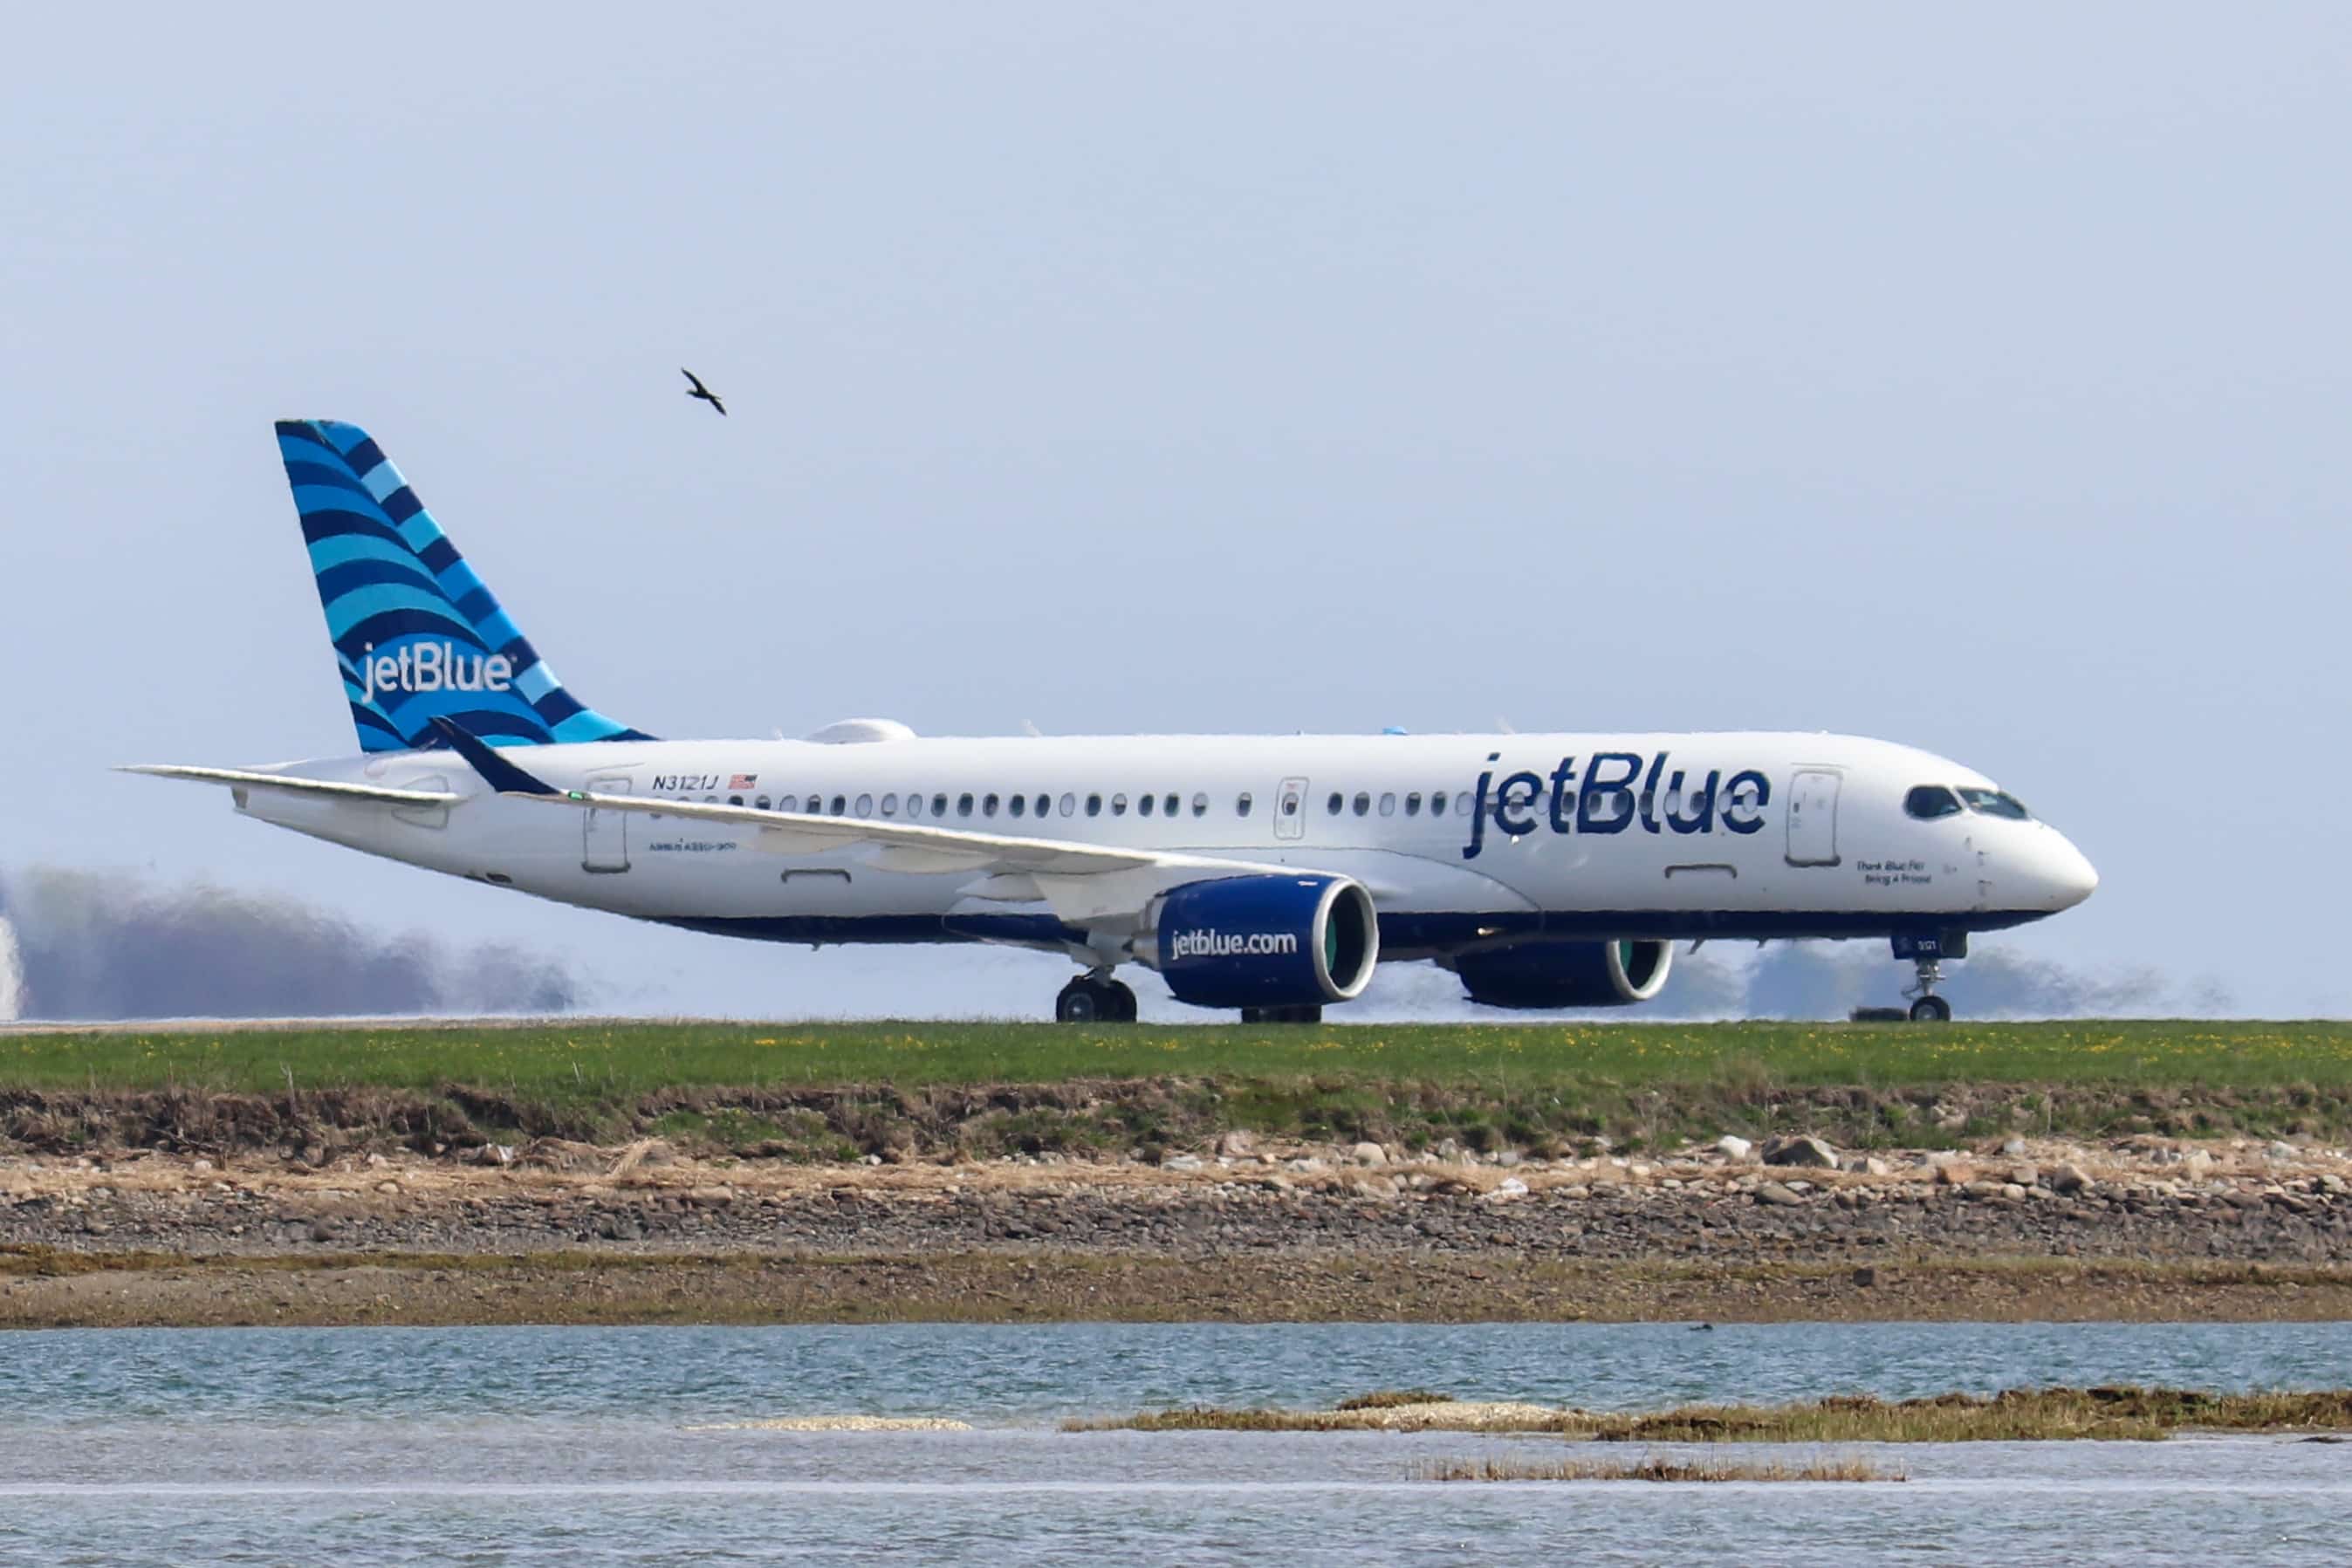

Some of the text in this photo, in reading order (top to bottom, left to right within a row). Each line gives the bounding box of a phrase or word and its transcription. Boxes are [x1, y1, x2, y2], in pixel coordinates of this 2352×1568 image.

[361, 642, 512, 703] jetBlue
[652, 774, 720, 791] N3121J
[1462, 751, 1772, 859] jetBlue
[1172, 928, 1297, 960] jetblue.com
